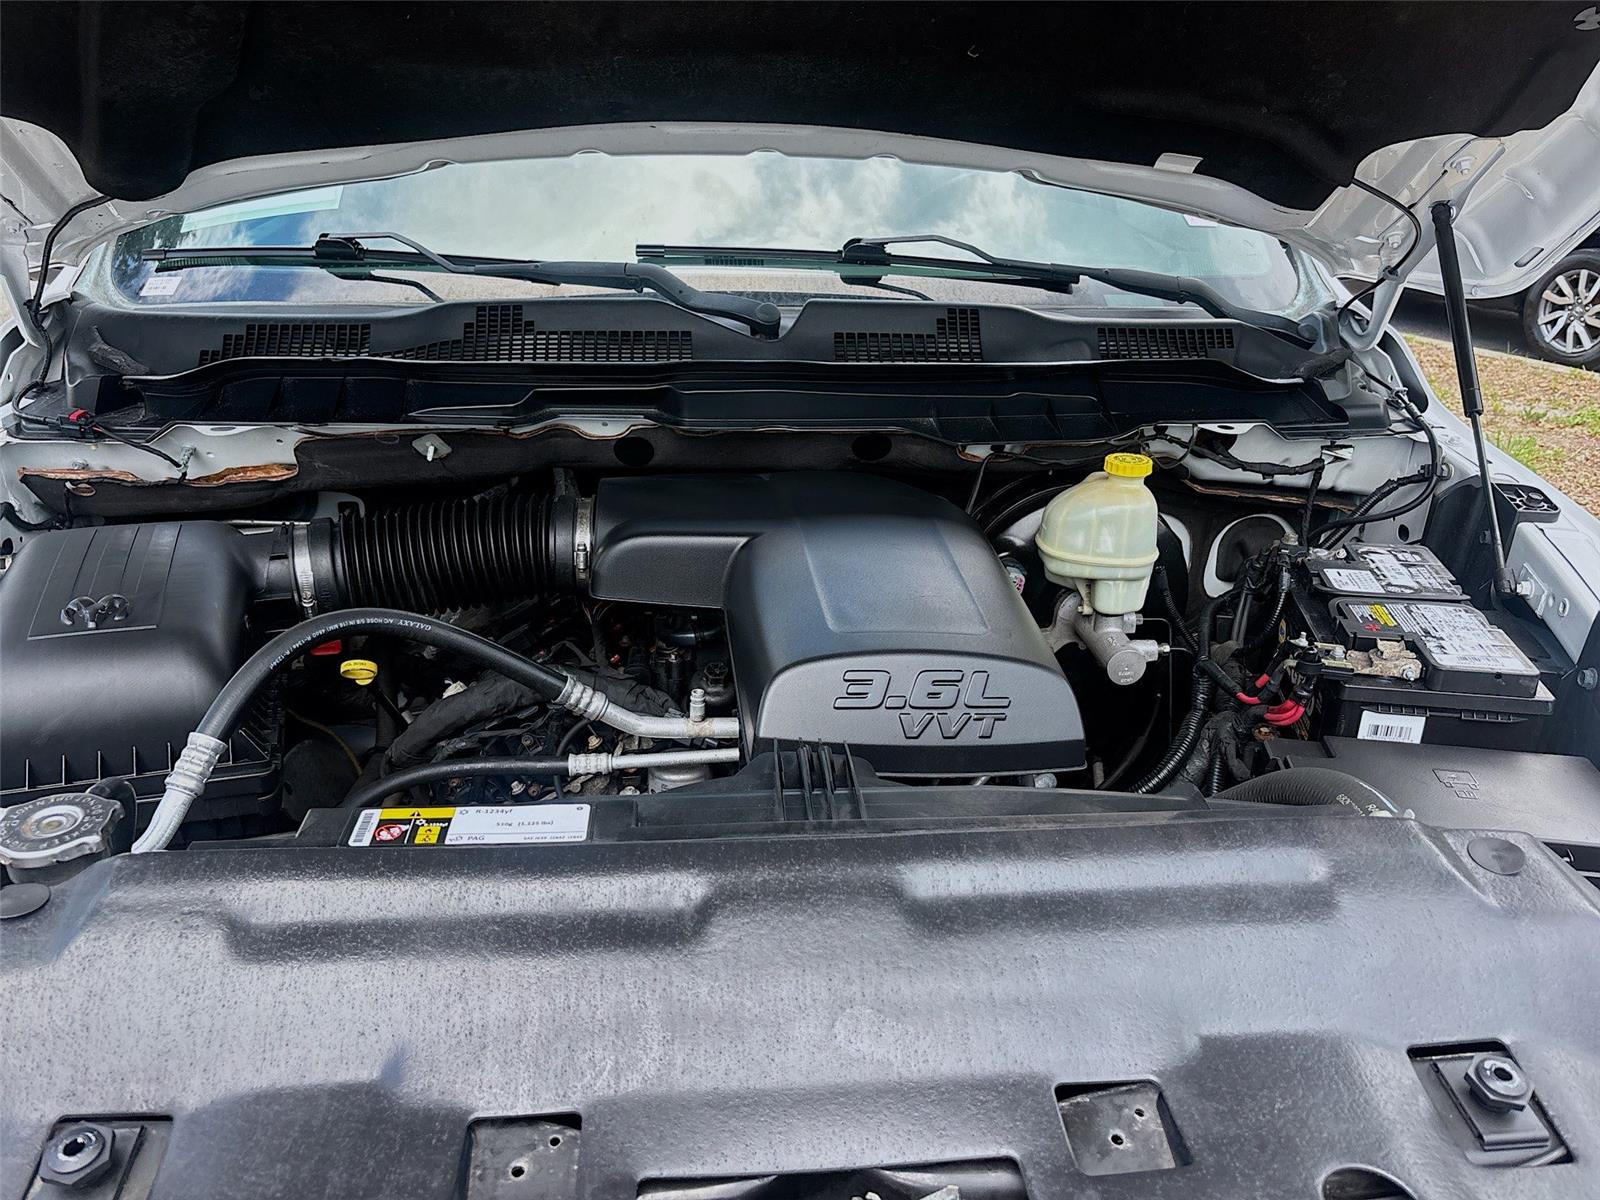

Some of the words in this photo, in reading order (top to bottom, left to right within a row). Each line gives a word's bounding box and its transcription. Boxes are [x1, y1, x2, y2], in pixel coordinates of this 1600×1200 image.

[365, 617, 383, 625] HOSE
[398, 618, 432, 631] GALAXY
[832, 669, 1011, 710] 3.6L
[898, 712, 1008, 740] VVT
[475, 807, 513, 816] R-1234yf
[466, 834, 486, 842] PAG
